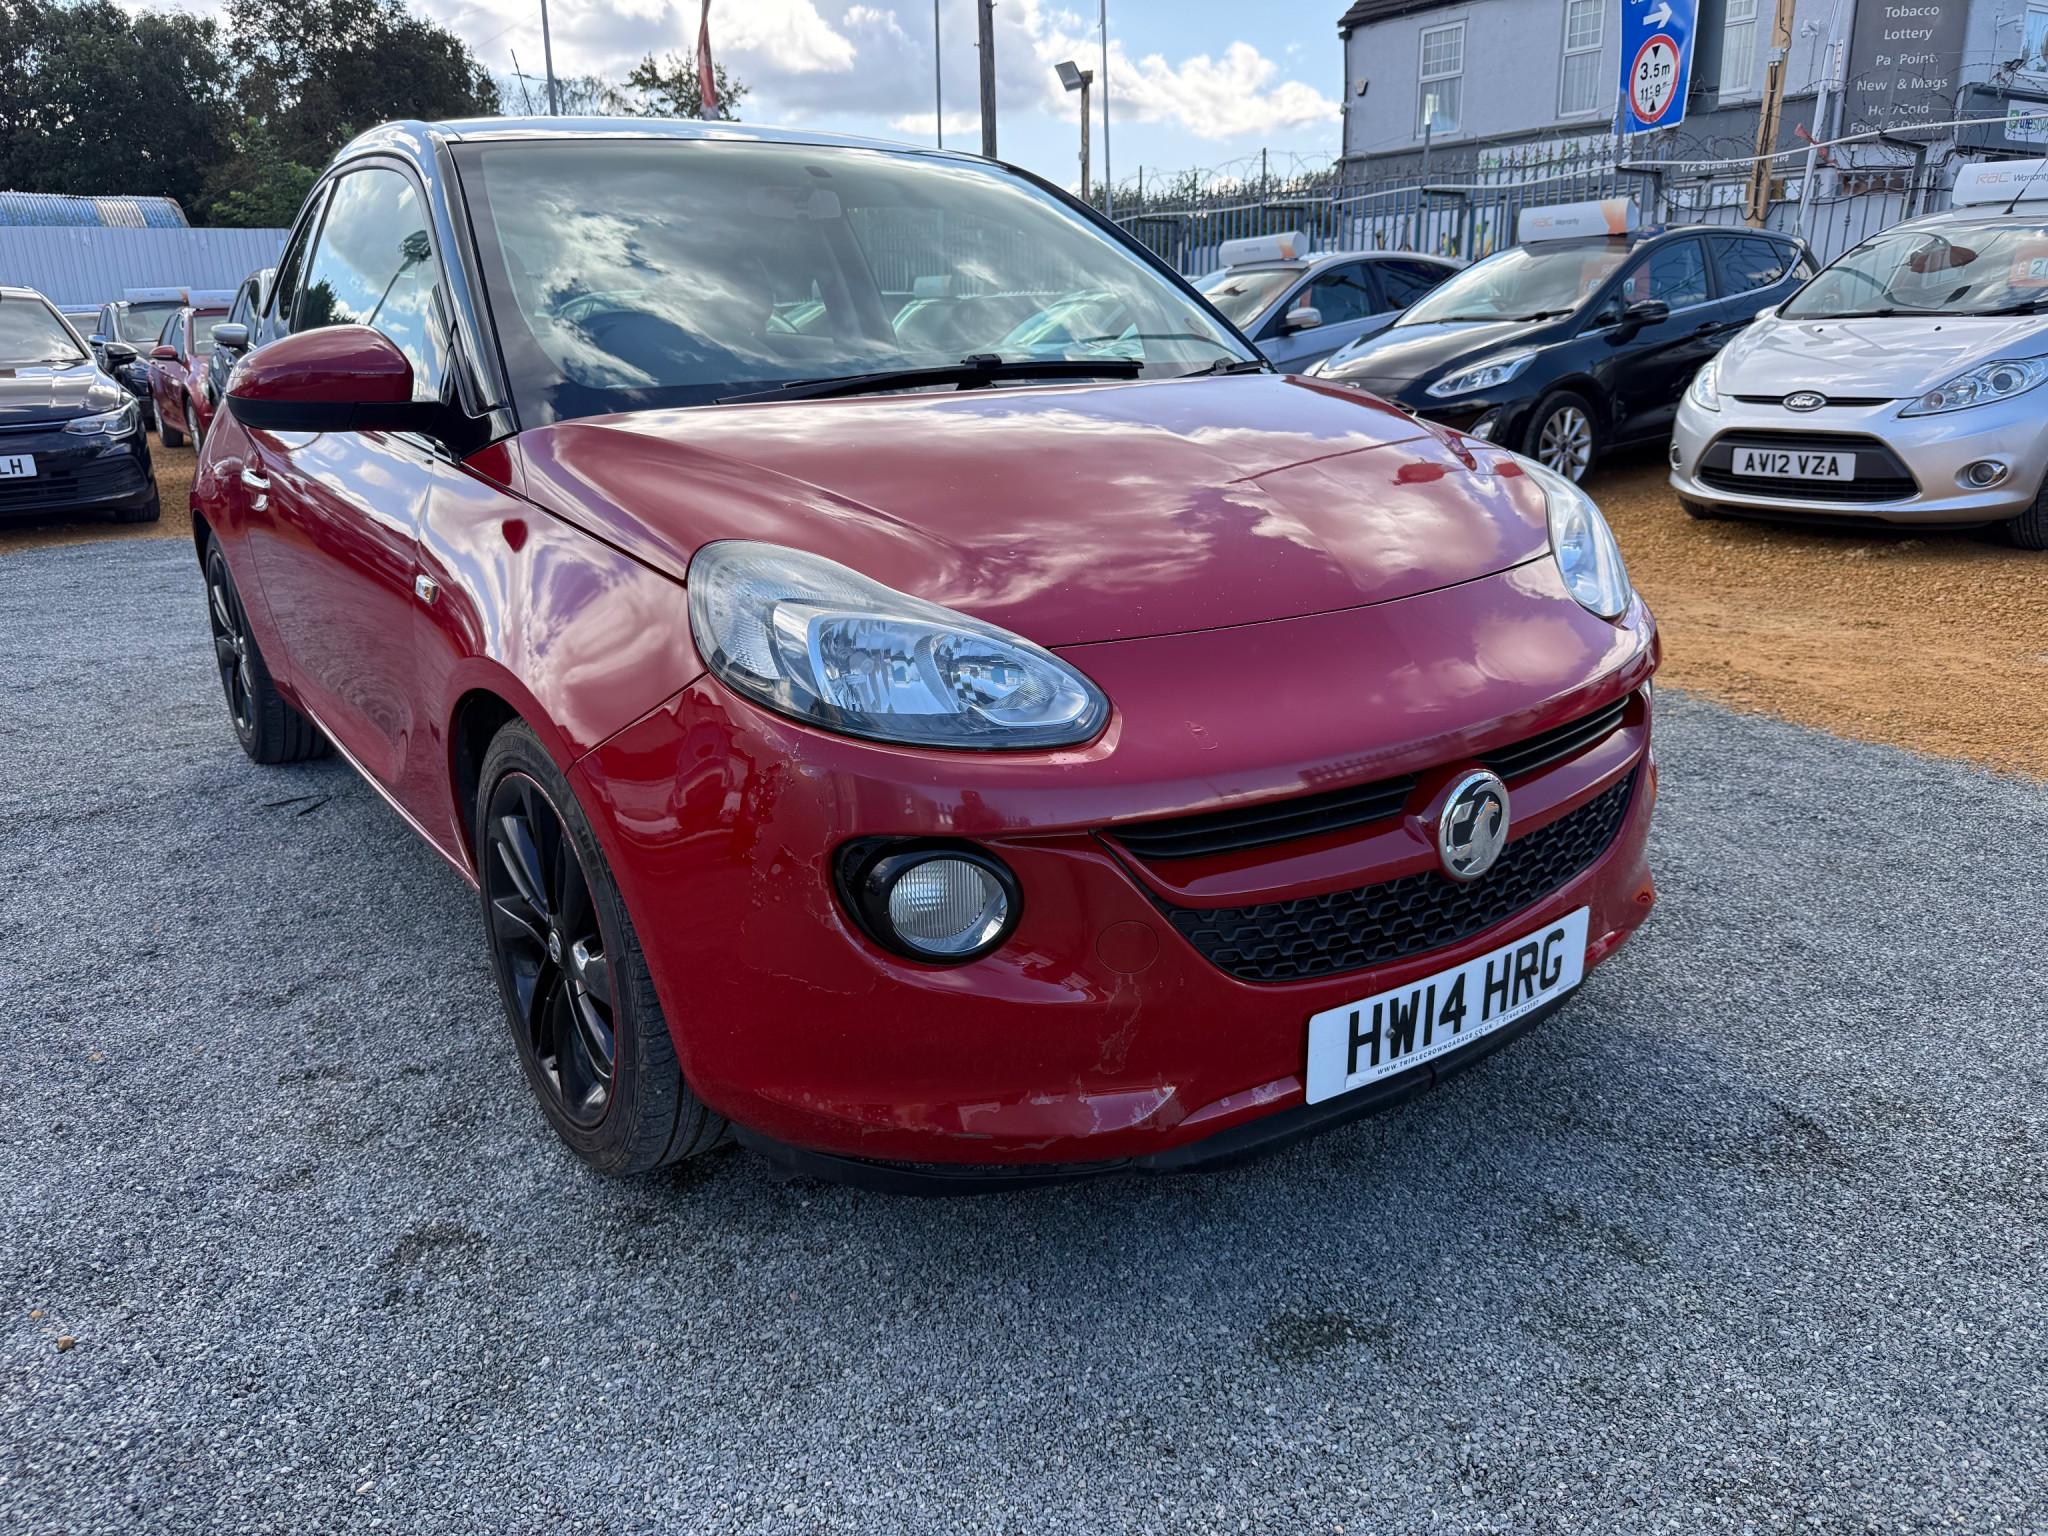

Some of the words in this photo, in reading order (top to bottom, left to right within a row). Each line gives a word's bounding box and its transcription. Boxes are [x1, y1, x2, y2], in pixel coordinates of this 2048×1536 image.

[1884, 5, 1940, 18] Tobacco
[1884, 28, 1934, 41] Lottery
[1875, 55, 1893, 66] Pa
[1899, 52, 1937, 65] Point
[1856, 80, 1889, 91] New
[1896, 78, 1908, 89] &
[1910, 77, 1948, 91] Mags
[1850, 121, 1882, 134] Food
[2014, 172, 2048, 182] Warrant
[1790, 395, 1816, 407] Ford
[1744, 453, 1790, 474] AV12
[1798, 455, 1840, 476] VZA
[1347, 972, 1467, 1075] HW14
[1481, 928, 1565, 1022] HRG
